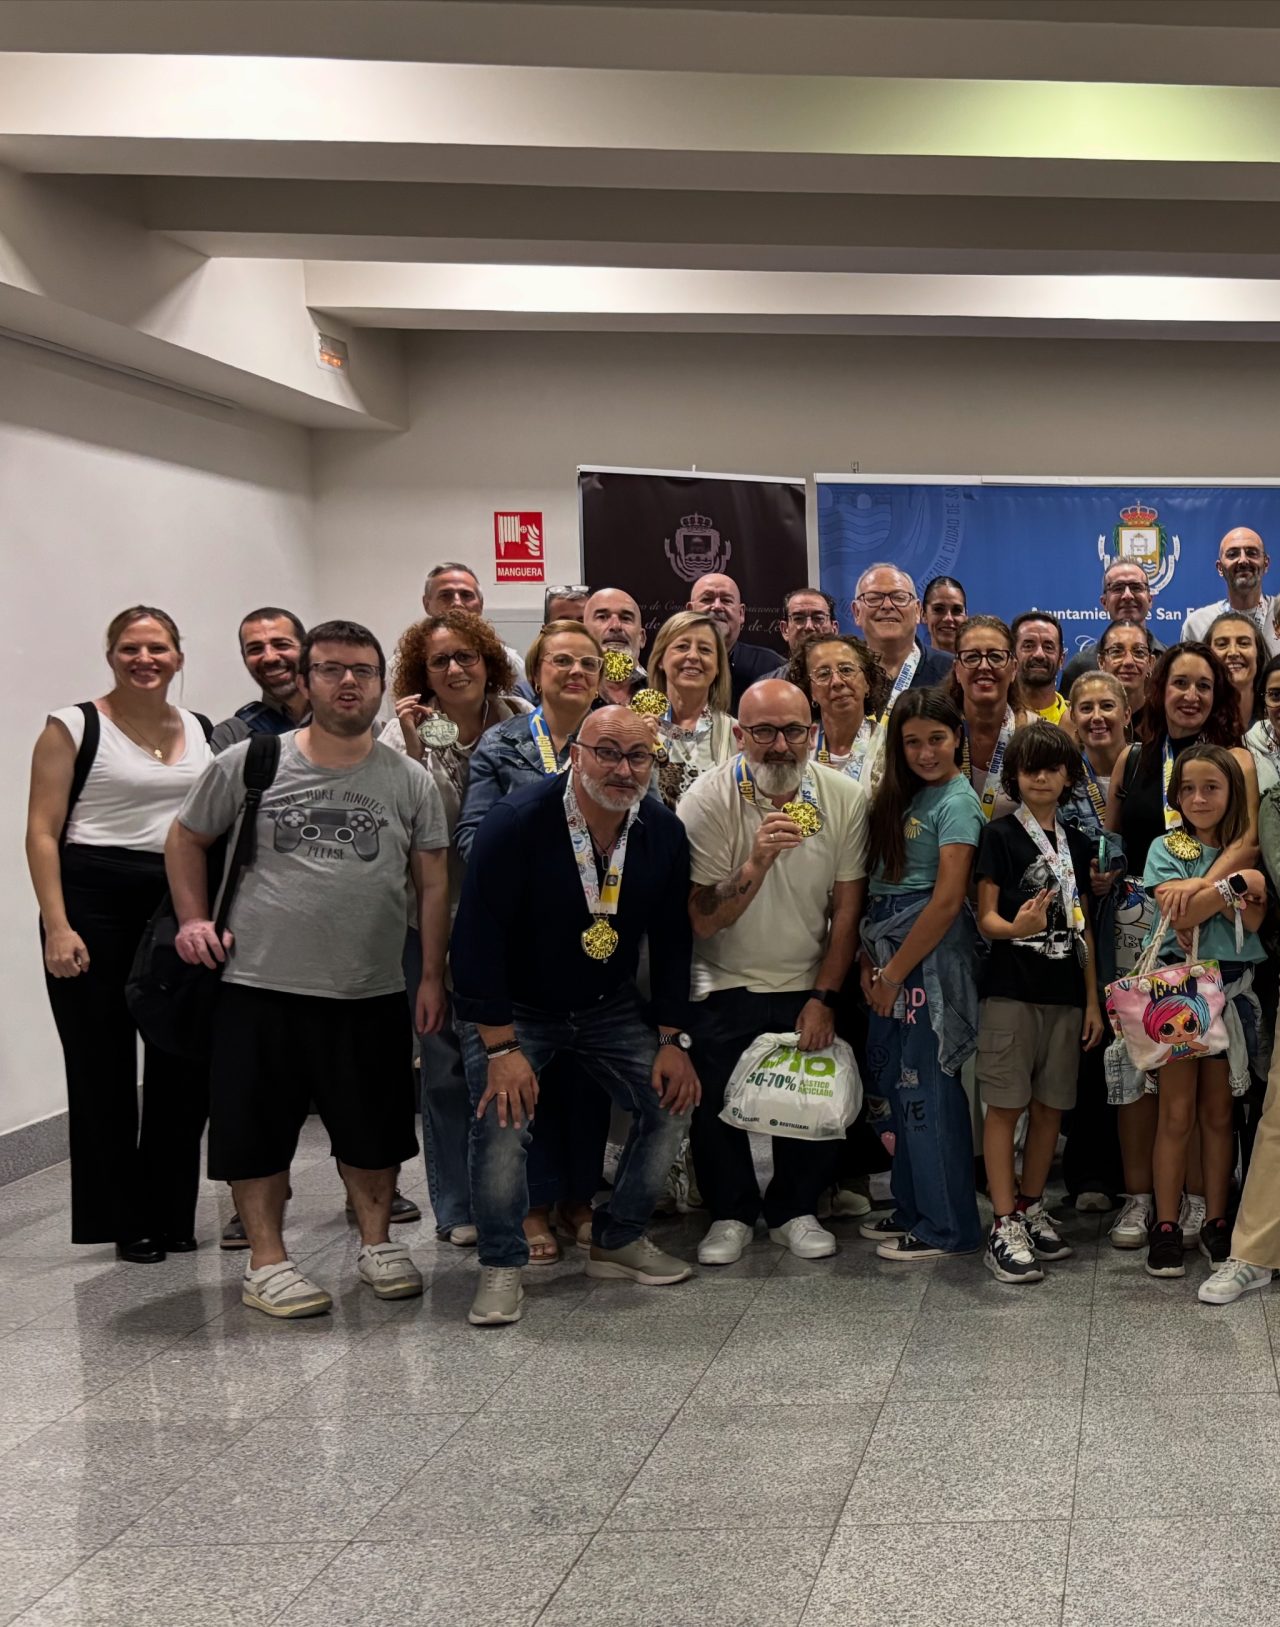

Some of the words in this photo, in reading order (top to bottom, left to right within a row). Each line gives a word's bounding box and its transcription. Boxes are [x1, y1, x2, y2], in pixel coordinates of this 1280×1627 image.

[942, 518, 960, 553] CIUDAD
[497, 567, 543, 576] MANGUERA
[1156, 607, 1182, 620] San
[894, 662, 912, 692] SANTIAGO
[989, 740, 1006, 775] SANTIAGO
[306, 789, 336, 801] MORE
[343, 791, 387, 815] MINUTES
[307, 846, 345, 860] PLEASE
